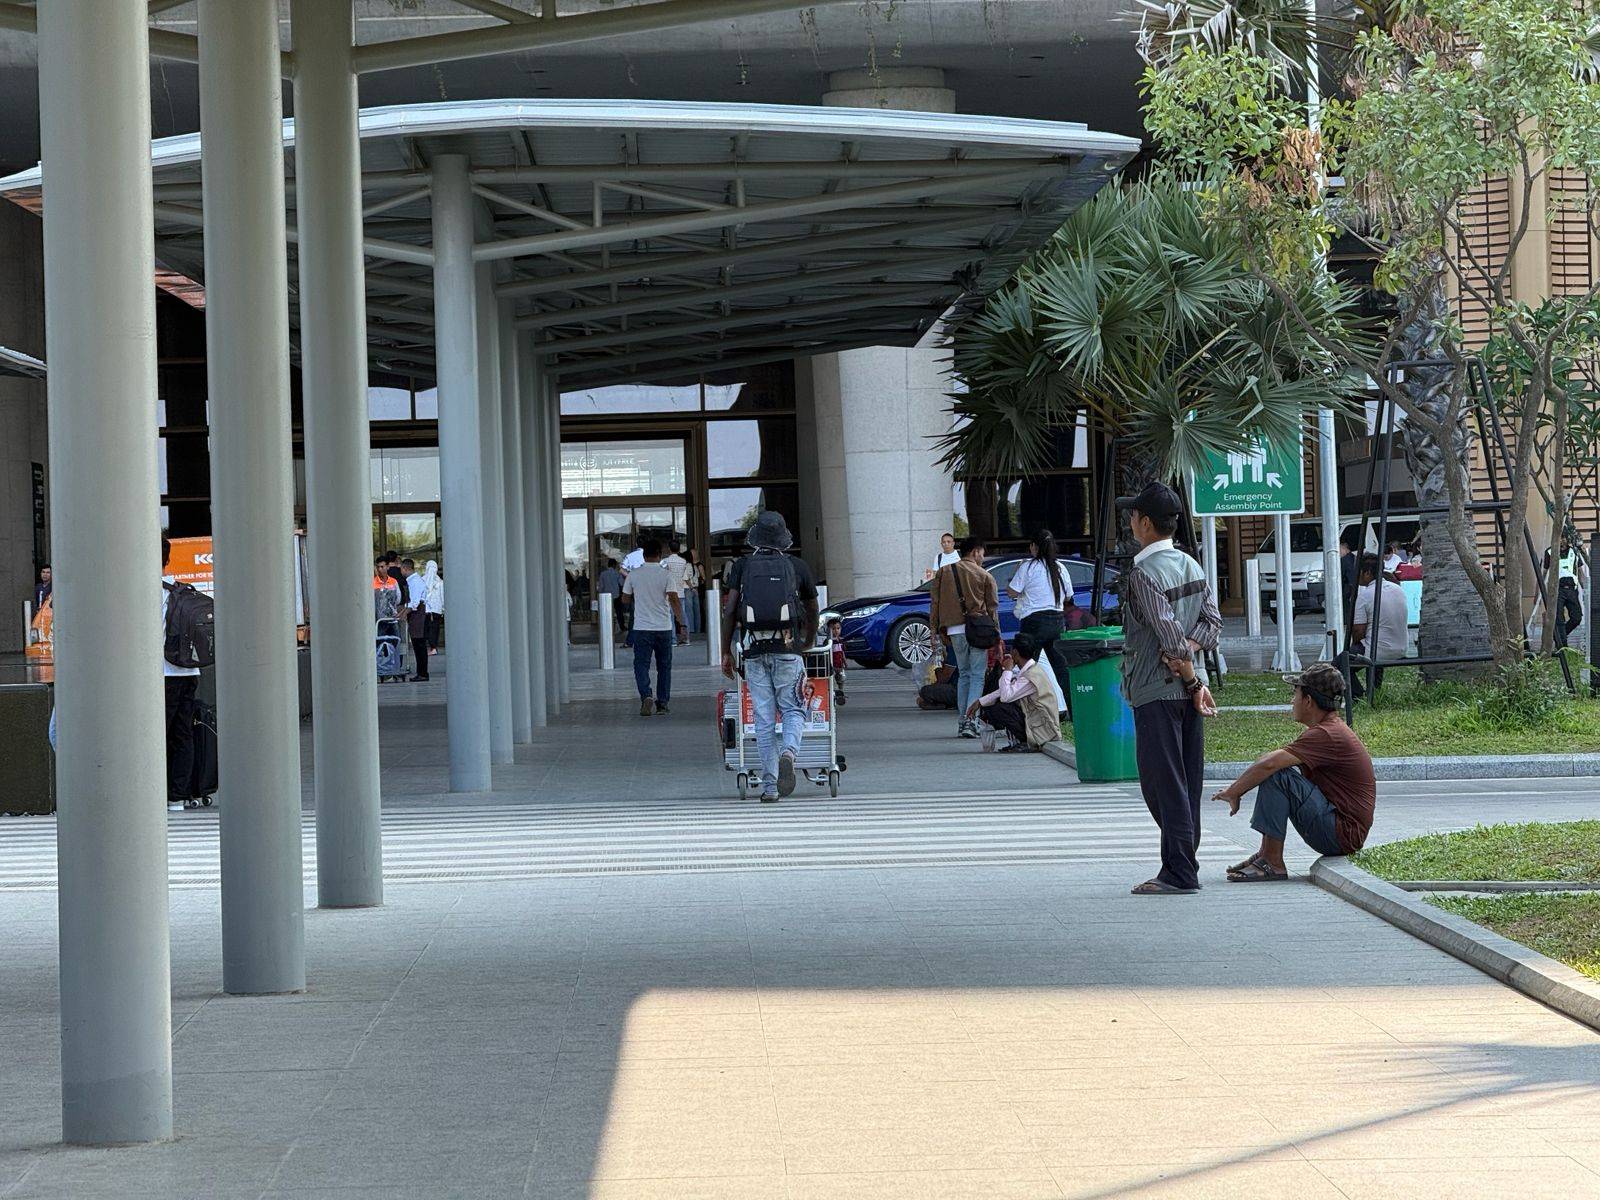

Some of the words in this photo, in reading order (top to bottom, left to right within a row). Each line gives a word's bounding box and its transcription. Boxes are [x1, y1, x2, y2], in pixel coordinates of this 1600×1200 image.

[1223, 493, 1272, 501] Emergency
[1215, 502, 1257, 510] Assembly
[1259, 501, 1282, 509] Point
